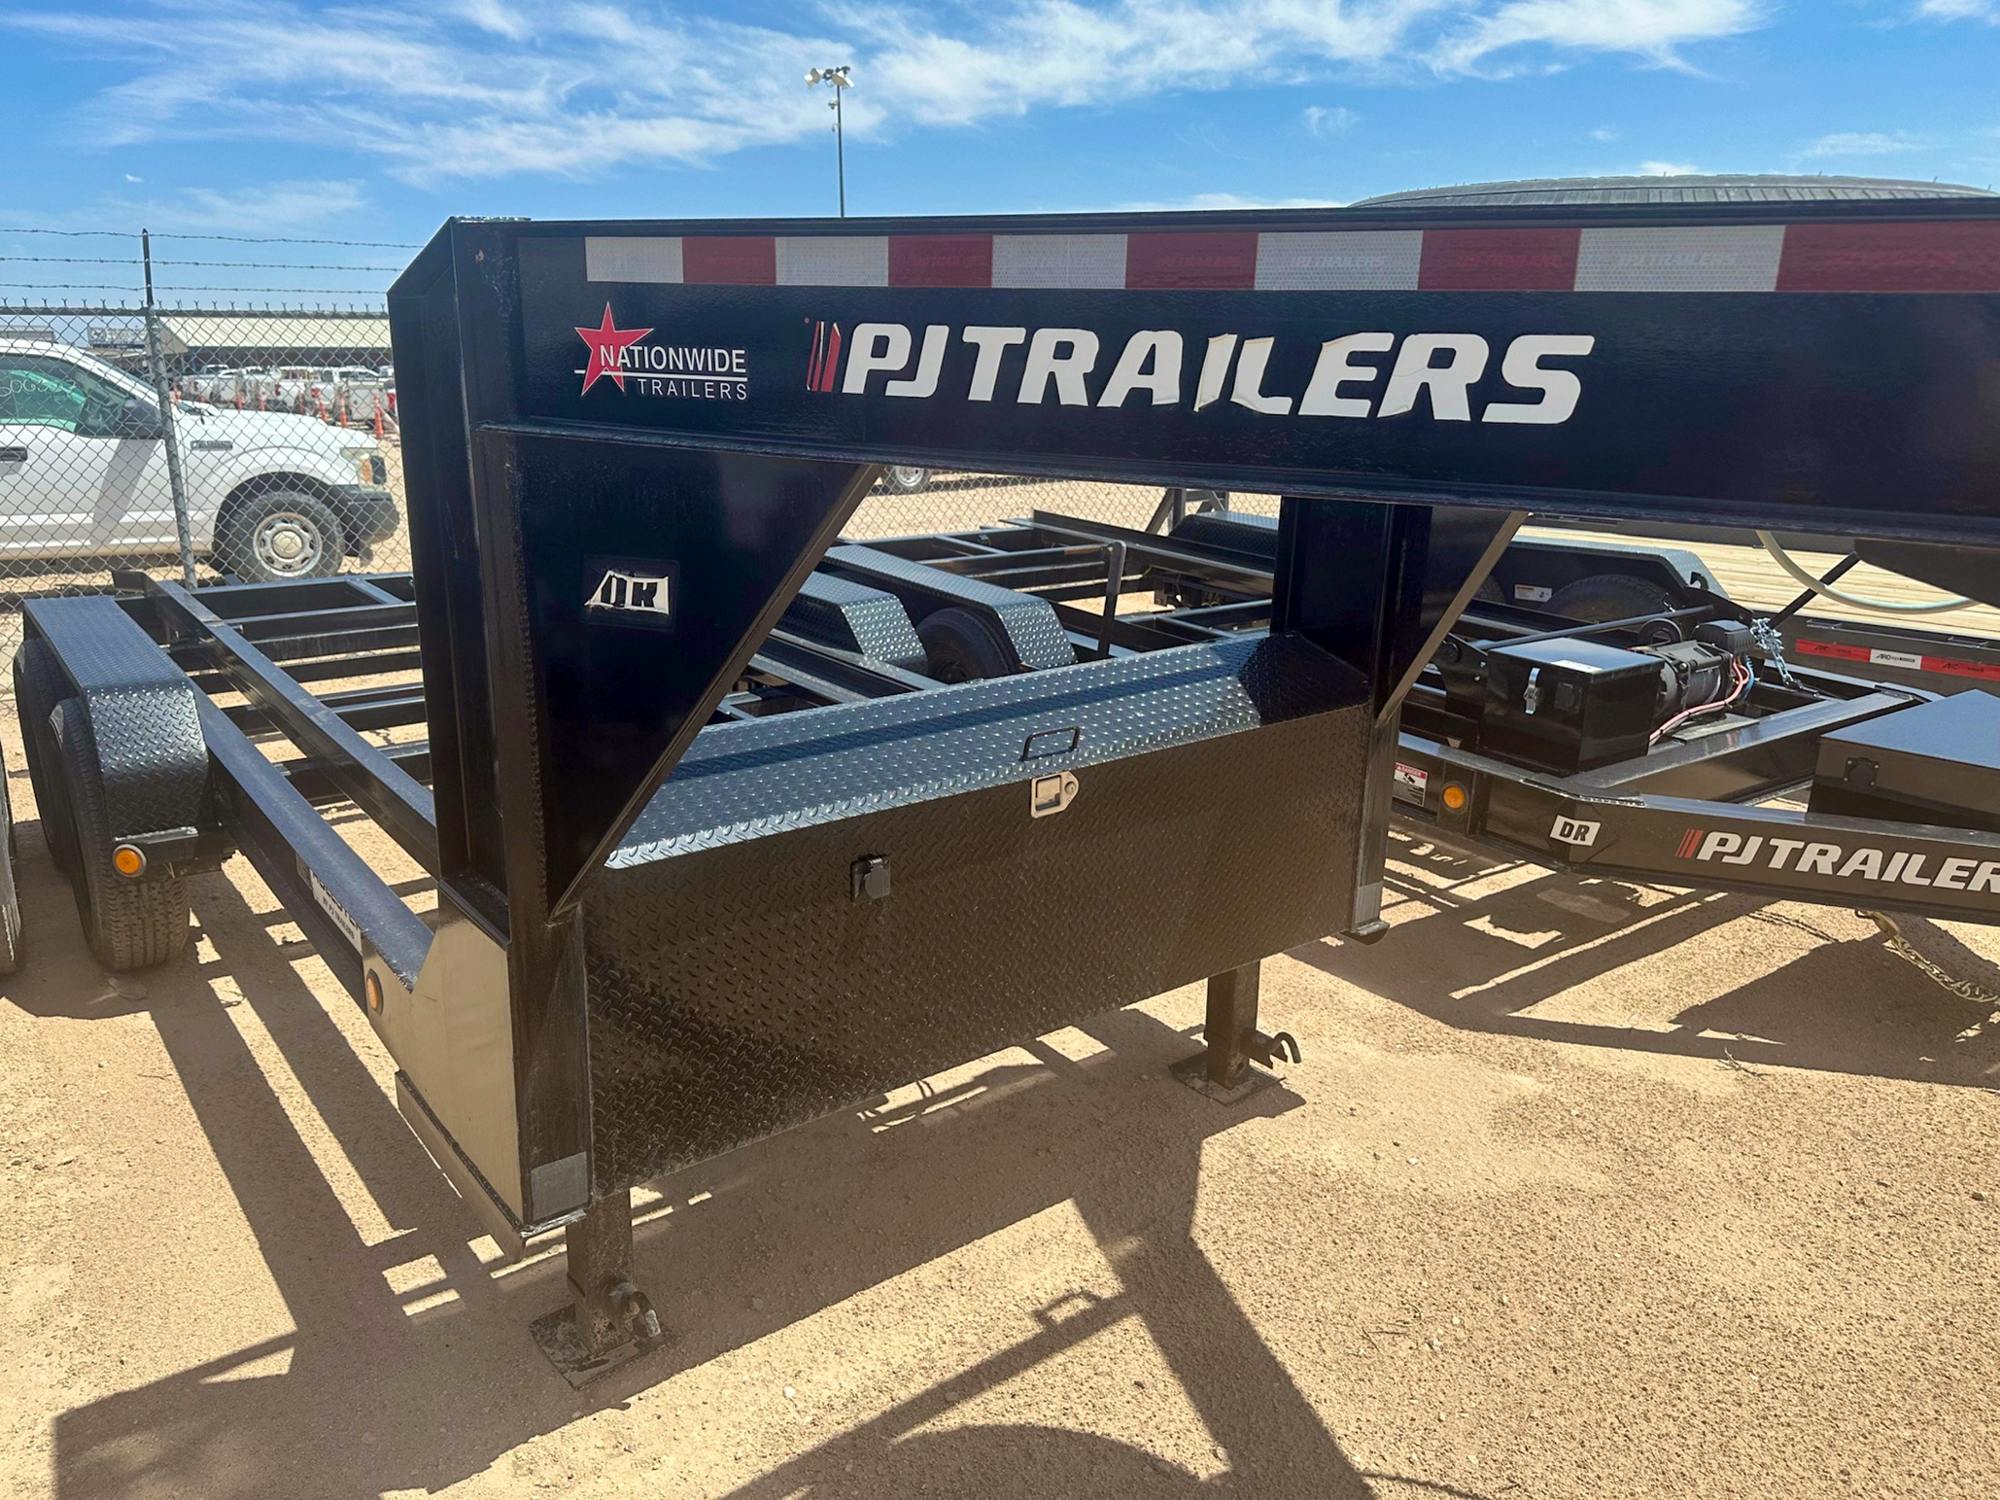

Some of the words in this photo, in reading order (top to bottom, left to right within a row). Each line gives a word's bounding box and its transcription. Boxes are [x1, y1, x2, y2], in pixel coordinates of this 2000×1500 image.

[600, 345, 747, 373] NATIONWIDE
[842, 323, 950, 398] PJ
[962, 326, 1596, 425] TRAILERS
[637, 378, 748, 400] TRAILERS
[1559, 820, 1590, 842] DR
[1696, 831, 1763, 865] PJ
